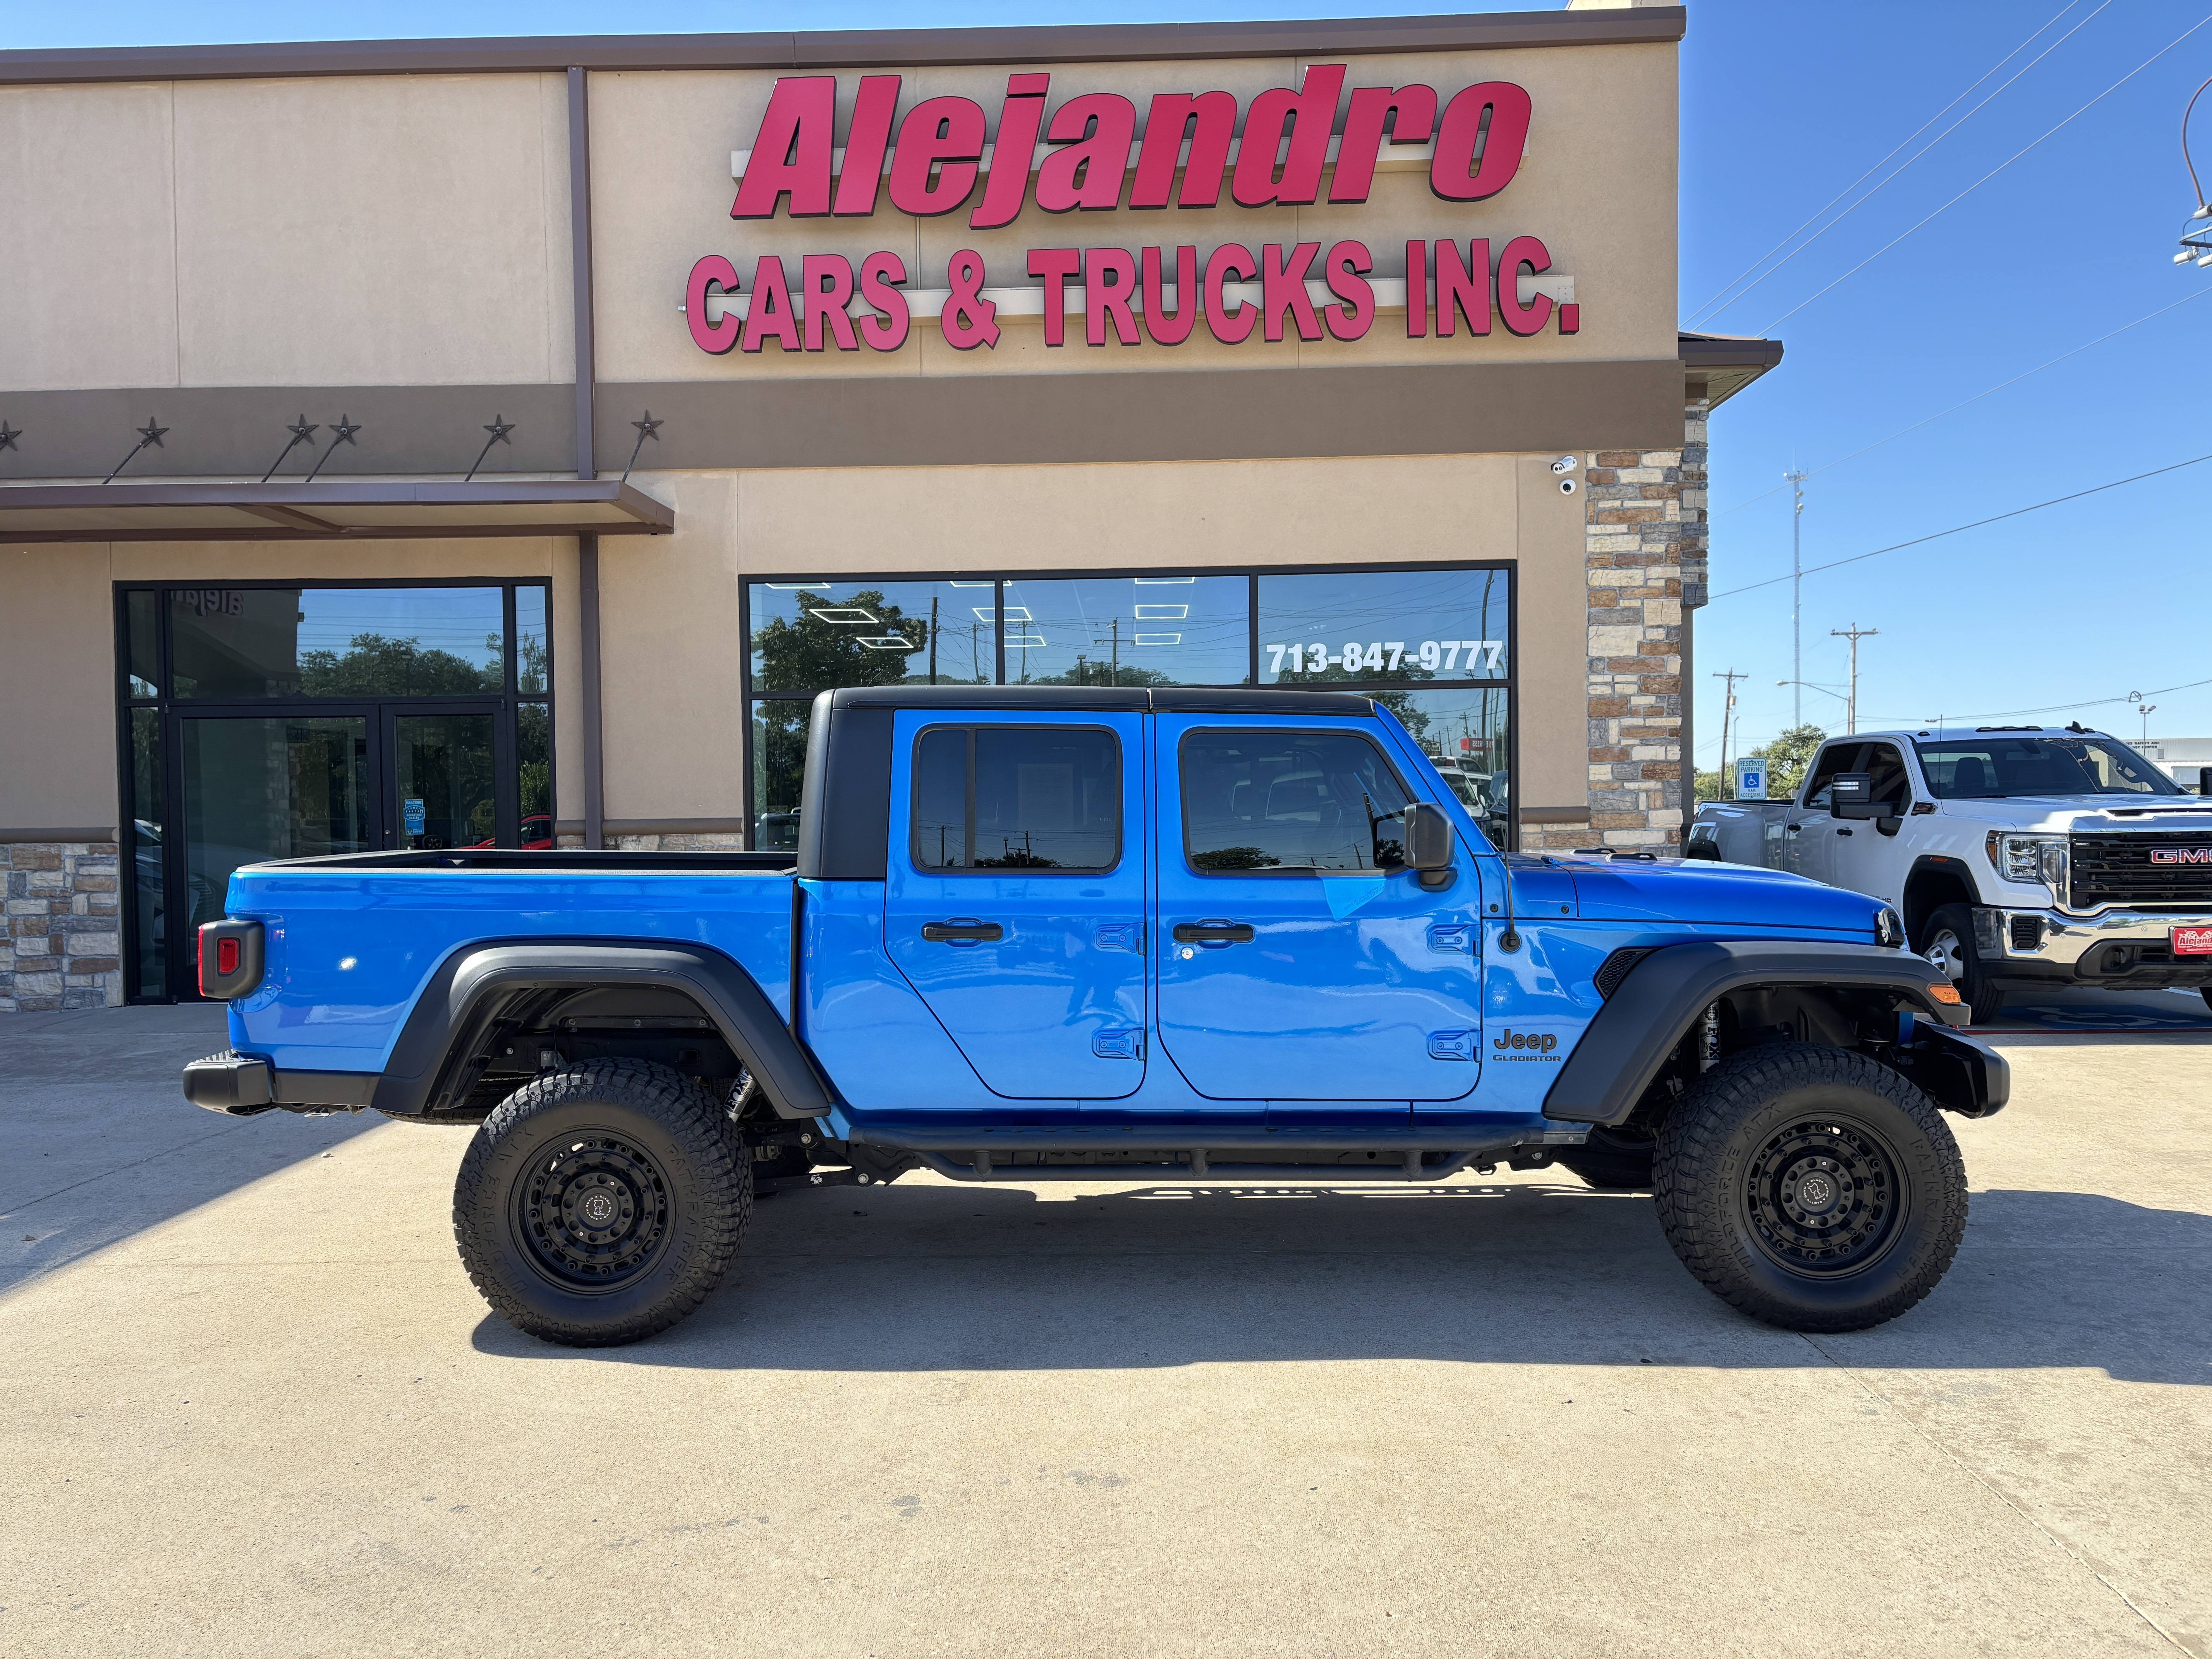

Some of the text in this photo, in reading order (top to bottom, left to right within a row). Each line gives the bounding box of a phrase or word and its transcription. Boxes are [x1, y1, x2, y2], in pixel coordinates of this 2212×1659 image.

[729, 64, 1532, 229] Alejandro
[685, 235, 1580, 355] CARS & TRUCKS INC.
[1266, 640, 1503, 673] 713-847-9777
[2151, 849, 2212, 864] GM
[1494, 1029, 1558, 1053] Jeep
